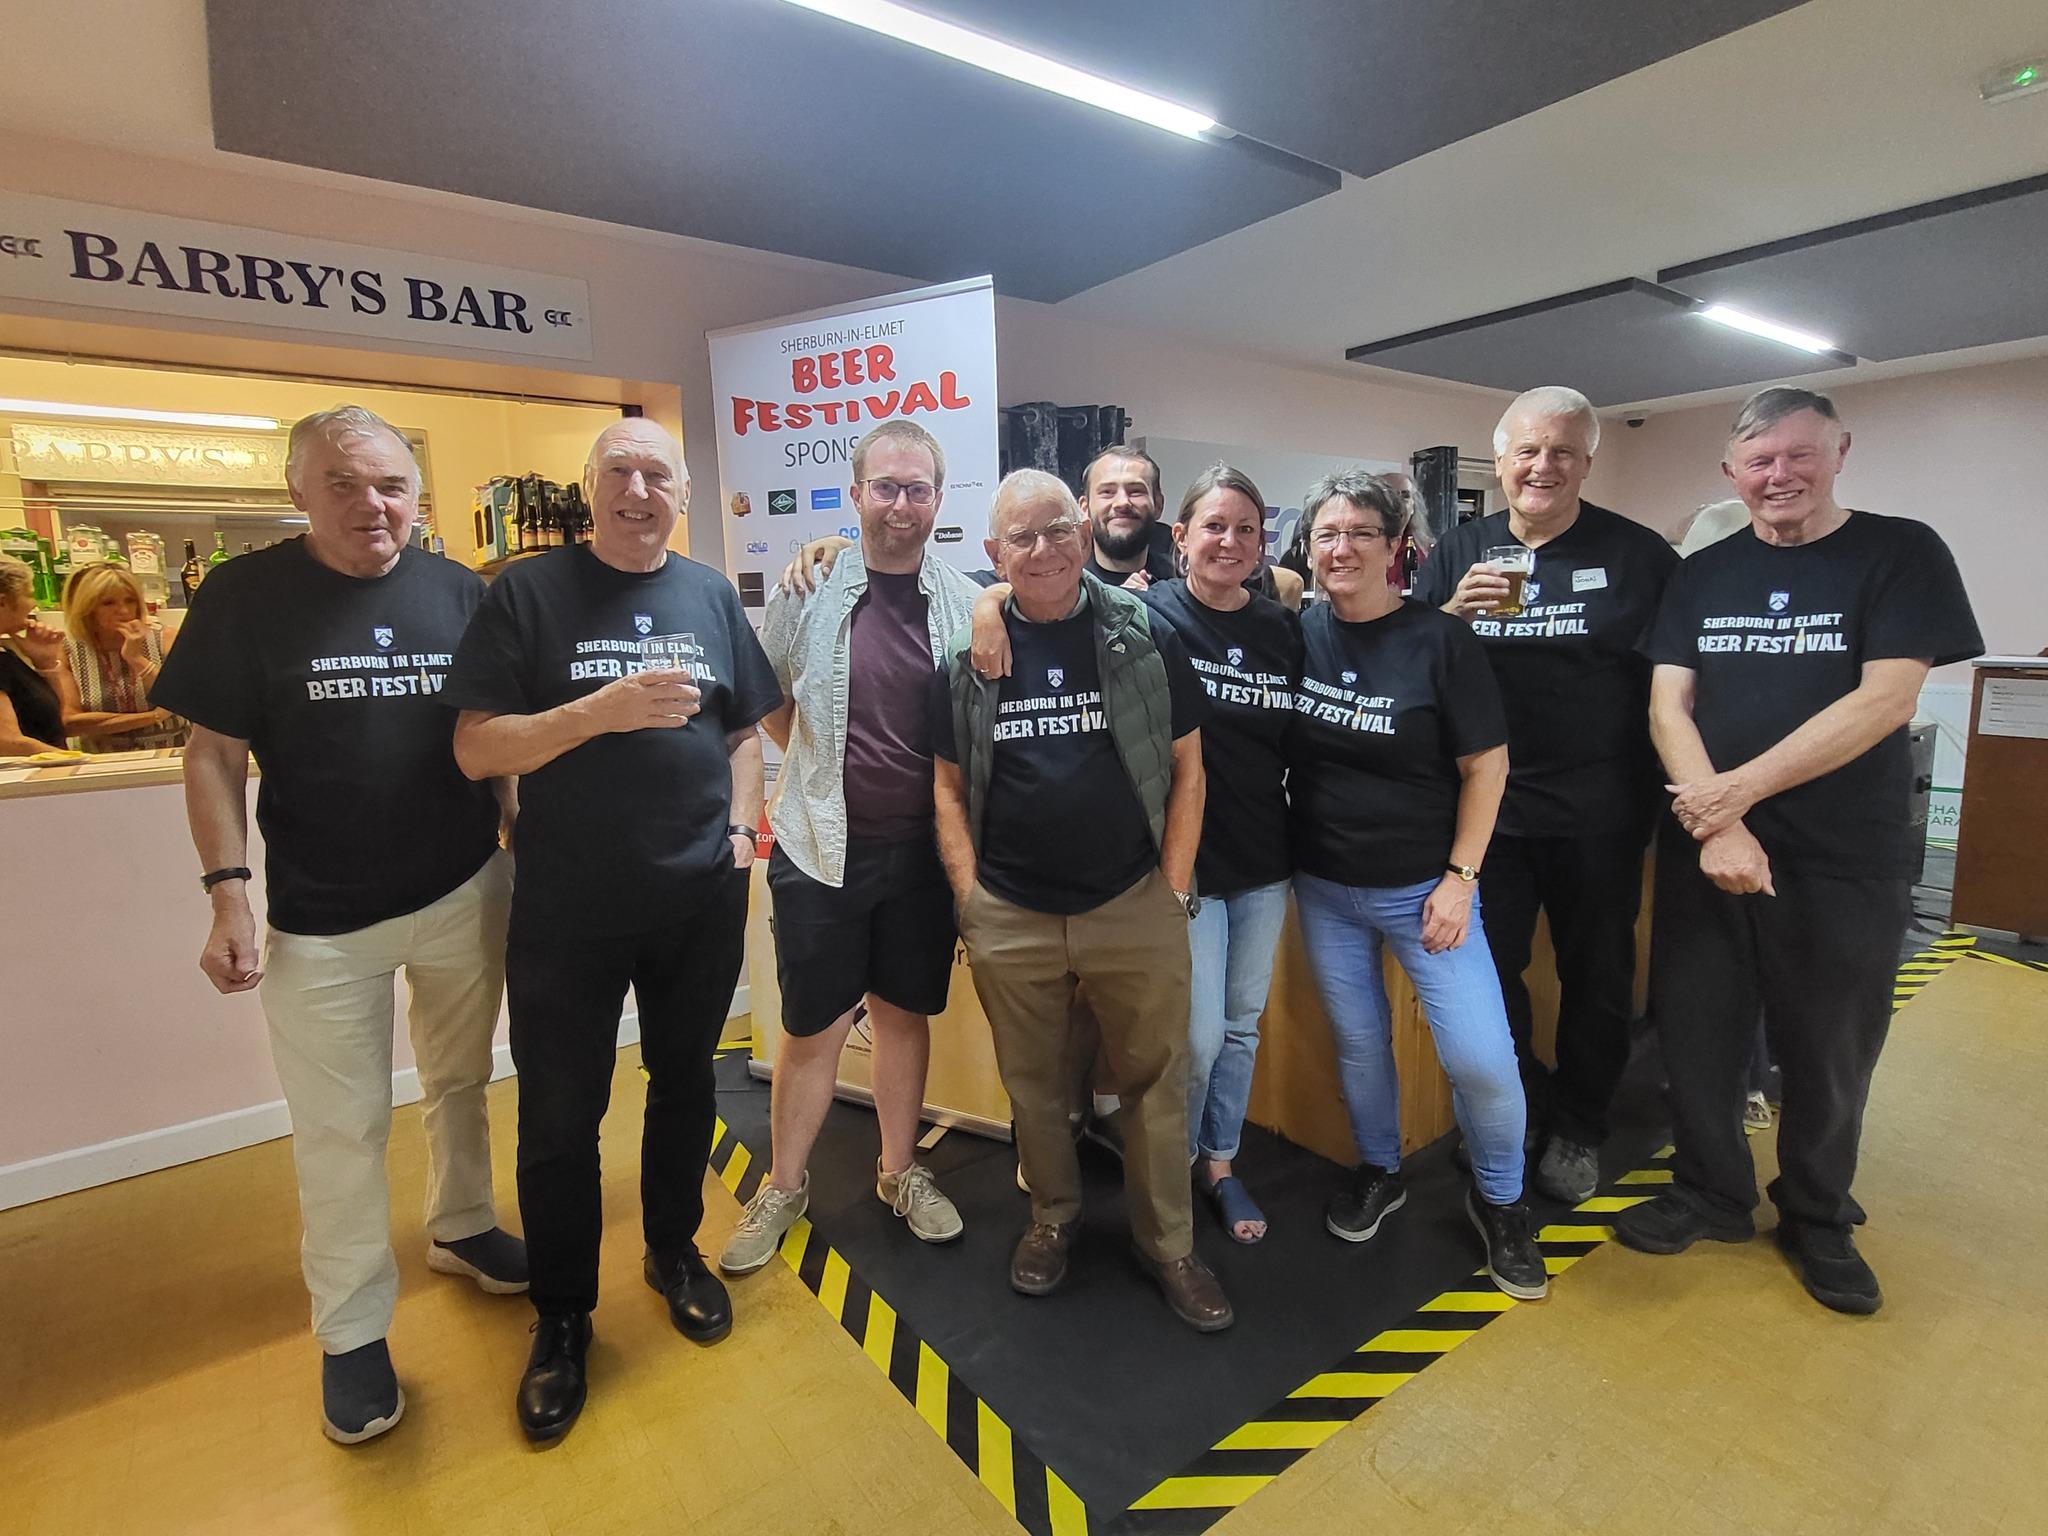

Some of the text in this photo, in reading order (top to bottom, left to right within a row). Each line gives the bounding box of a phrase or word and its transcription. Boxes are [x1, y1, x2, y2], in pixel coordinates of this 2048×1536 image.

[64, 229, 386, 315] BARRY'S
[403, 278, 534, 334] BAR
[780, 320, 905, 354] SHERBURN-IN-ELMET
[792, 344, 897, 394] BEER
[731, 371, 972, 436] FESTIVAL
[1545, 603, 1586, 616] ELMET
[1472, 615, 1589, 637] EER FESTIVAL
[1703, 614, 1843, 629] SHERBURN IN ELMET
[576, 640, 648, 654] SHERBURN
[650, 643, 664, 654] IN
[1697, 628, 1848, 654] BEER FESTIVAL
[311, 654, 453, 672] SHERBURN IN ELMET
[570, 659, 622, 680] BEER
[306, 667, 447, 700] BEER FESTIV
[1060, 695, 1073, 708] IN
[1077, 691, 1102, 706] ELM
[1355, 695, 1394, 708] ELMET
[1313, 702, 1395, 734] FESTIVAL
[993, 719, 1034, 742] BEER
